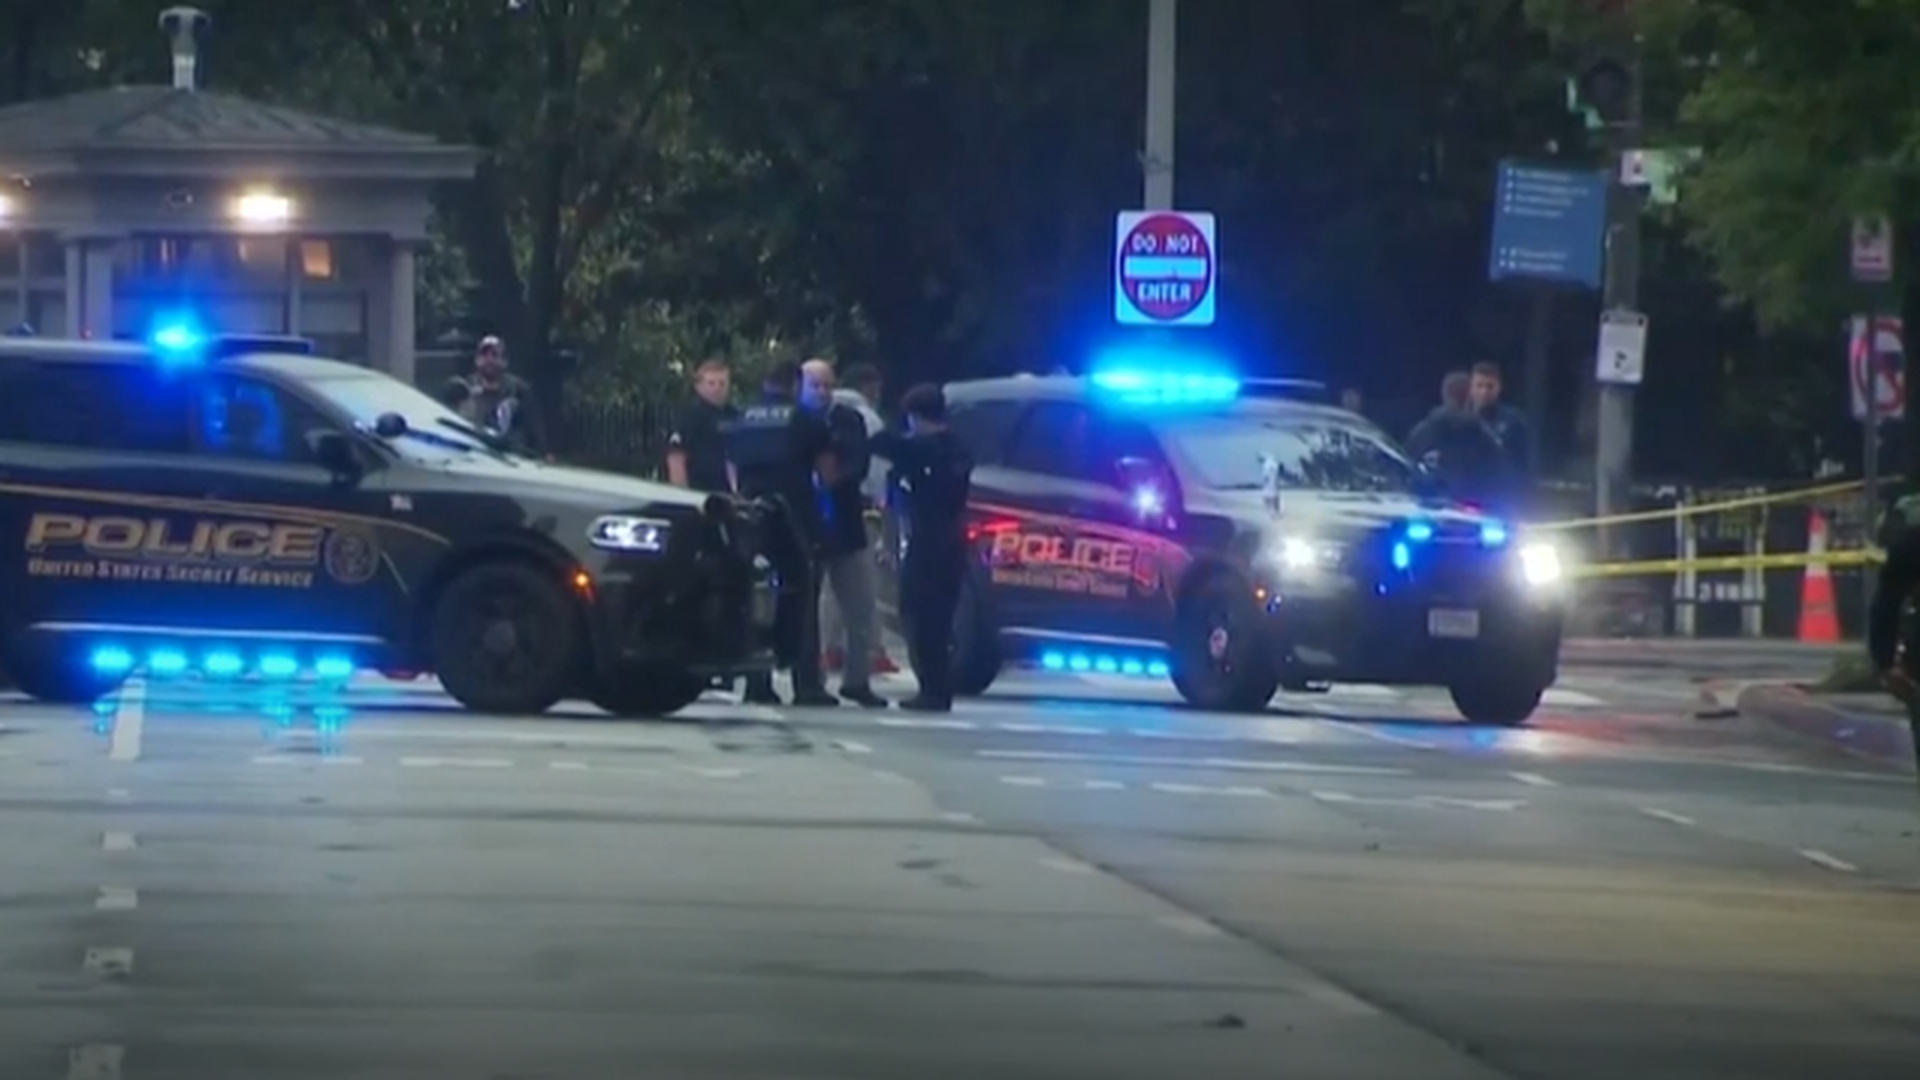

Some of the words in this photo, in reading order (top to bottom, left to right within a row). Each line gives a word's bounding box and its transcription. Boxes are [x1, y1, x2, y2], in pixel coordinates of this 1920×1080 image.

[1132, 233, 1157, 252] DO
[1165, 234, 1199, 254] NOT
[1138, 282, 1192, 303] ENTER
[25, 512, 322, 564] POLICE
[991, 531, 1134, 572] POLICE
[28, 557, 95, 577] UNITED
[97, 560, 163, 581] STATES
[166, 564, 233, 585] SECRET
[236, 566, 314, 588] SERVICE
